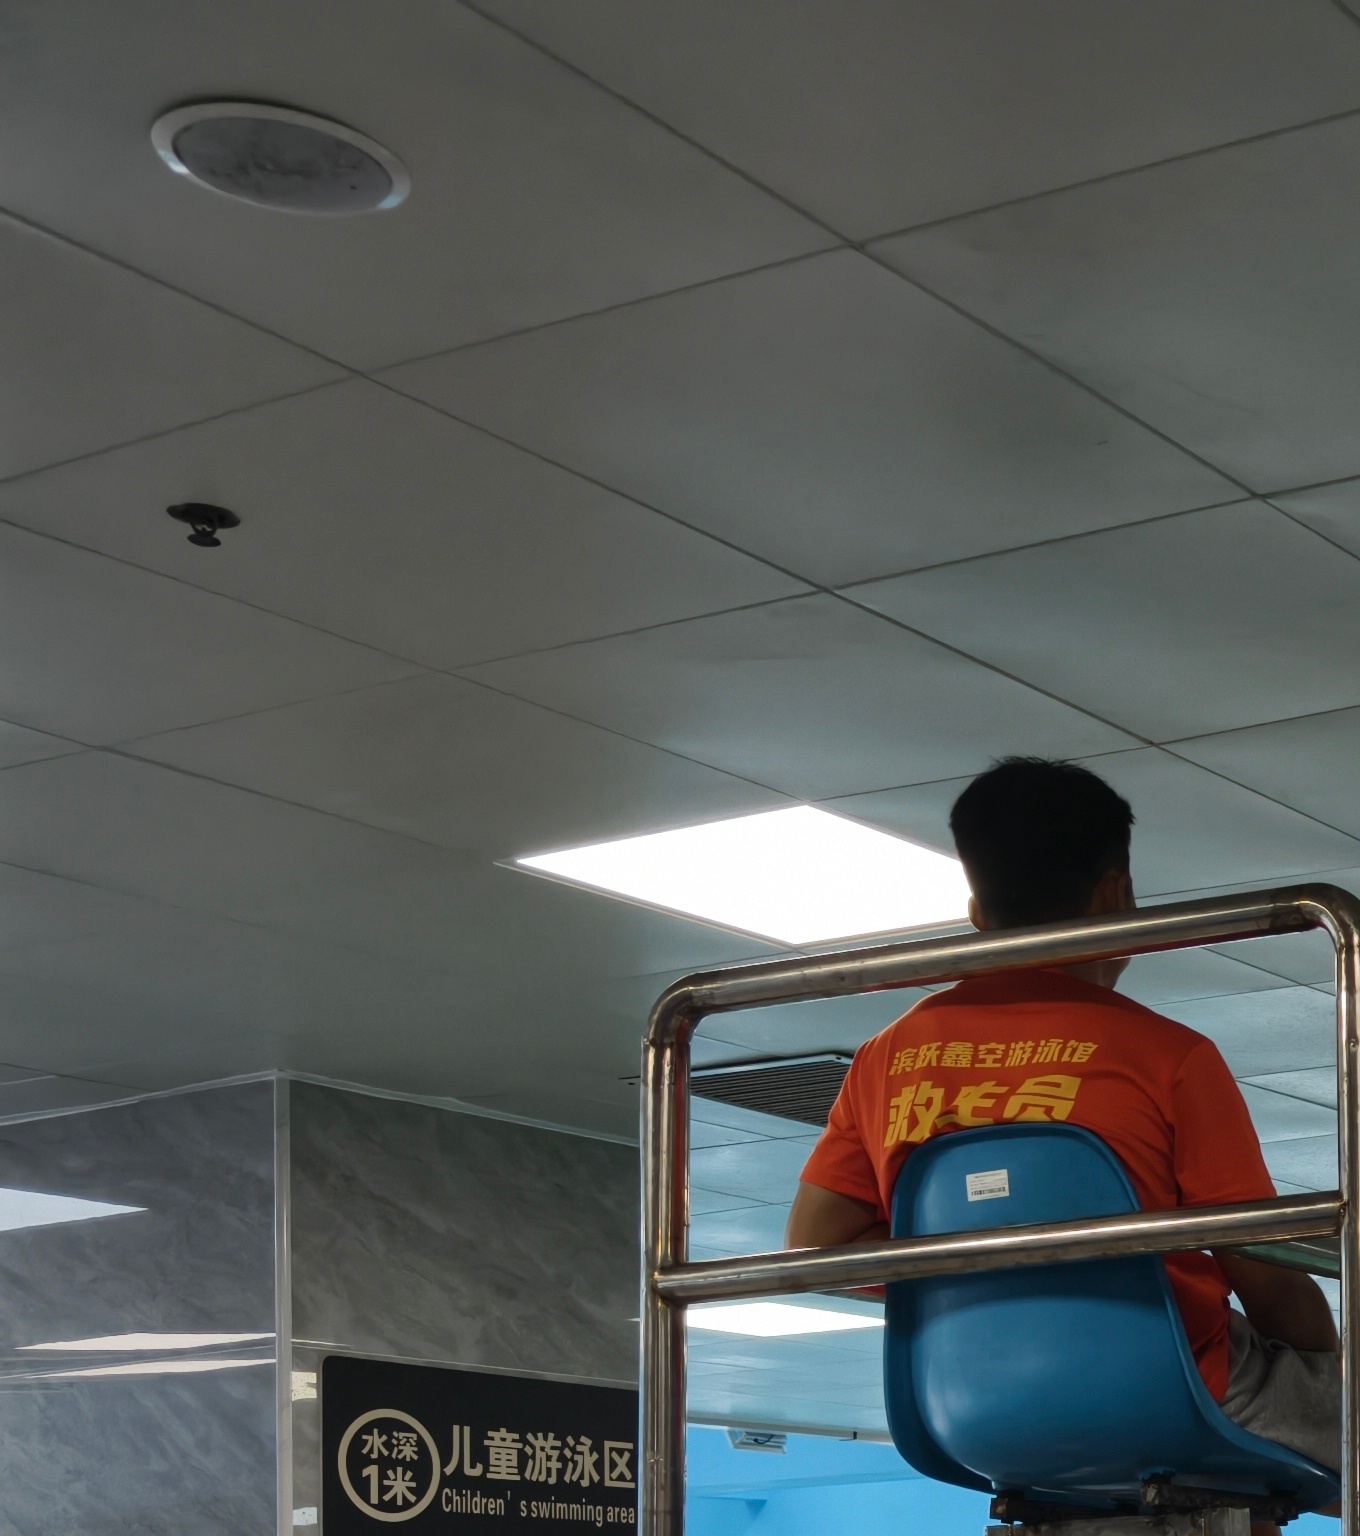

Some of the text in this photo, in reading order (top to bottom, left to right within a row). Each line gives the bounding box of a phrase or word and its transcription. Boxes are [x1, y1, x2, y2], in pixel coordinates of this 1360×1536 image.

[883, 1074, 1082, 1148] 救生员
[361, 1428, 418, 1462] 水深
[443, 1425, 636, 1488] 儿童游泳区
[361, 1464, 417, 1506] 1米
[530, 1497, 603, 1527] swimming
[606, 1505, 635, 1524] area
